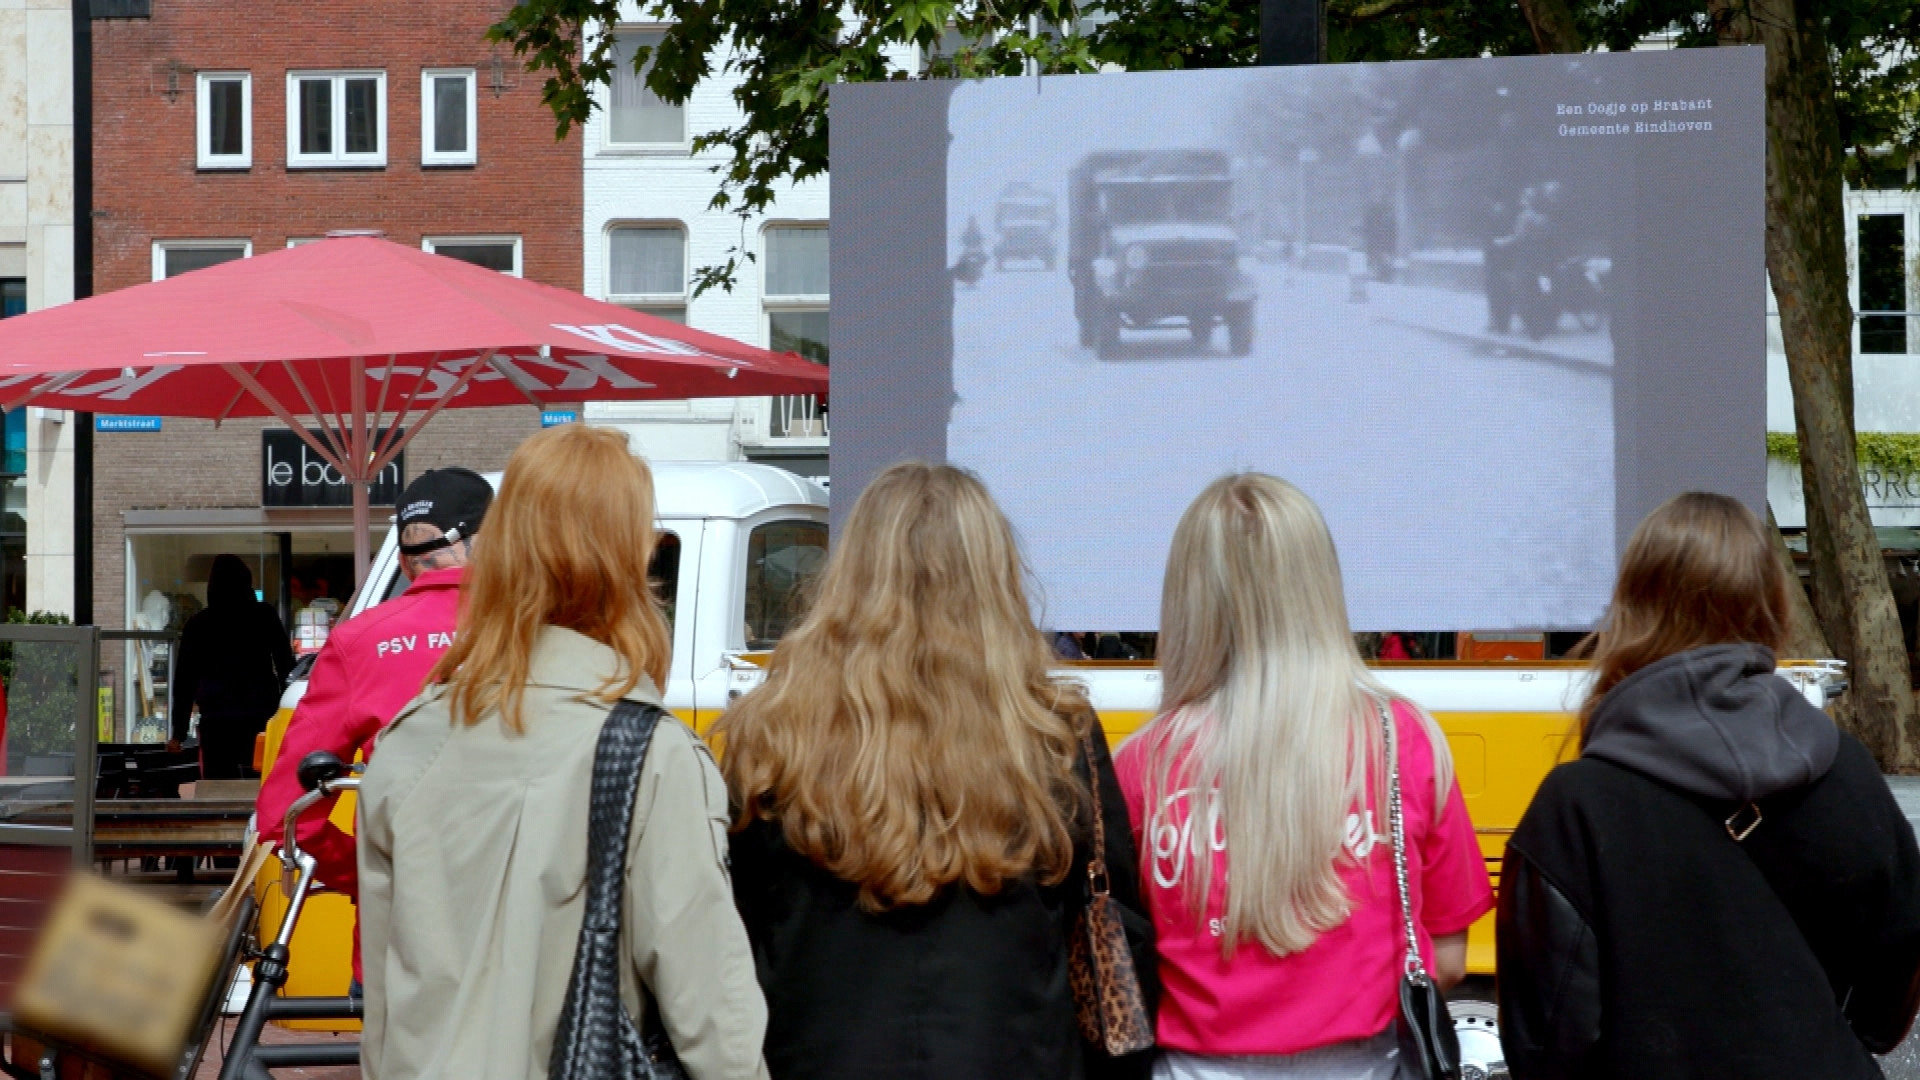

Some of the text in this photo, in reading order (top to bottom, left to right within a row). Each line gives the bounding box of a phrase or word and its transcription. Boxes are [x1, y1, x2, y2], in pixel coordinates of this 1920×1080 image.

[1556, 98, 1713, 116] Een Oogje op Brabant
[1558, 119, 1713, 137] Gemeente Eindhoven
[100, 419, 155, 429] Marktstraat
[544, 413, 572, 423] Markt
[267, 443, 293, 486] le
[376, 631, 458, 659] PSV FA
